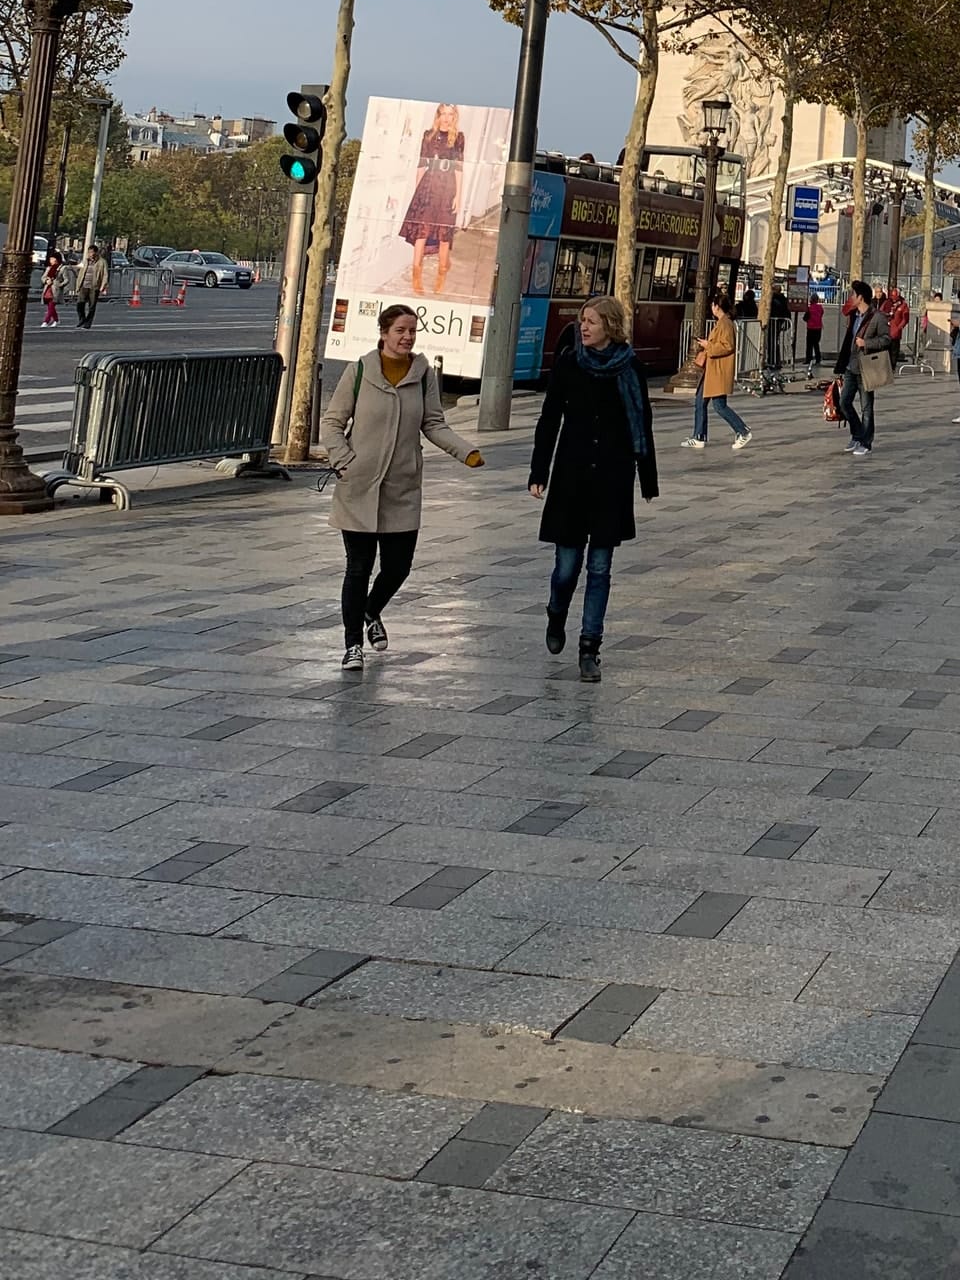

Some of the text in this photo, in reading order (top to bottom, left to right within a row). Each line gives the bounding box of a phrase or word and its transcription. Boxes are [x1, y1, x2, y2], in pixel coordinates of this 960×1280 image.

[635, 209, 700, 237] ESCARSROUGES
[378, 302, 464, 337] &sh
[330, 338, 341, 347] 70
